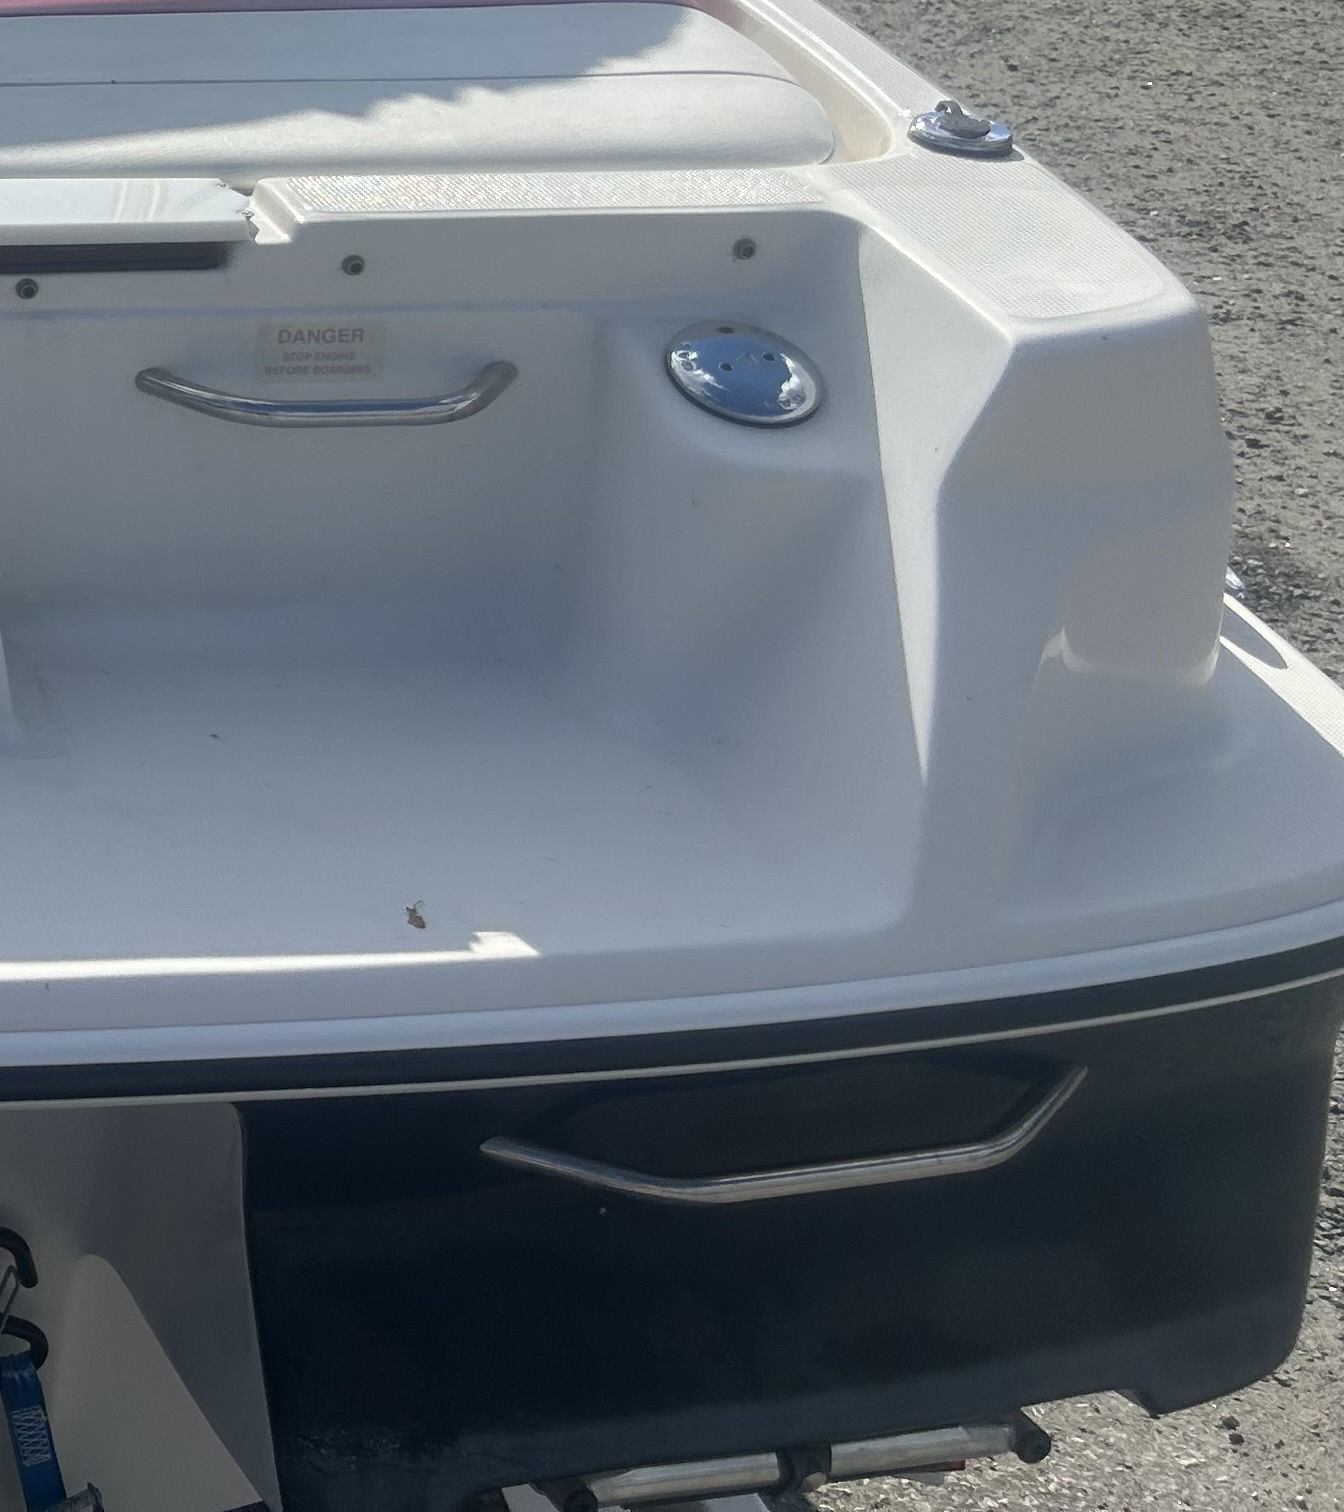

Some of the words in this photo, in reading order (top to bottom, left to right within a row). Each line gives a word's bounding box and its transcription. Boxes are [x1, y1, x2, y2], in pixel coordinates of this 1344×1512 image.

[277, 328, 365, 344] DANGER
[283, 352, 312, 362] STOP
[314, 351, 357, 361] ENGINE
[265, 366, 311, 376] BEFORE
[313, 365, 371, 375] BOARDING
